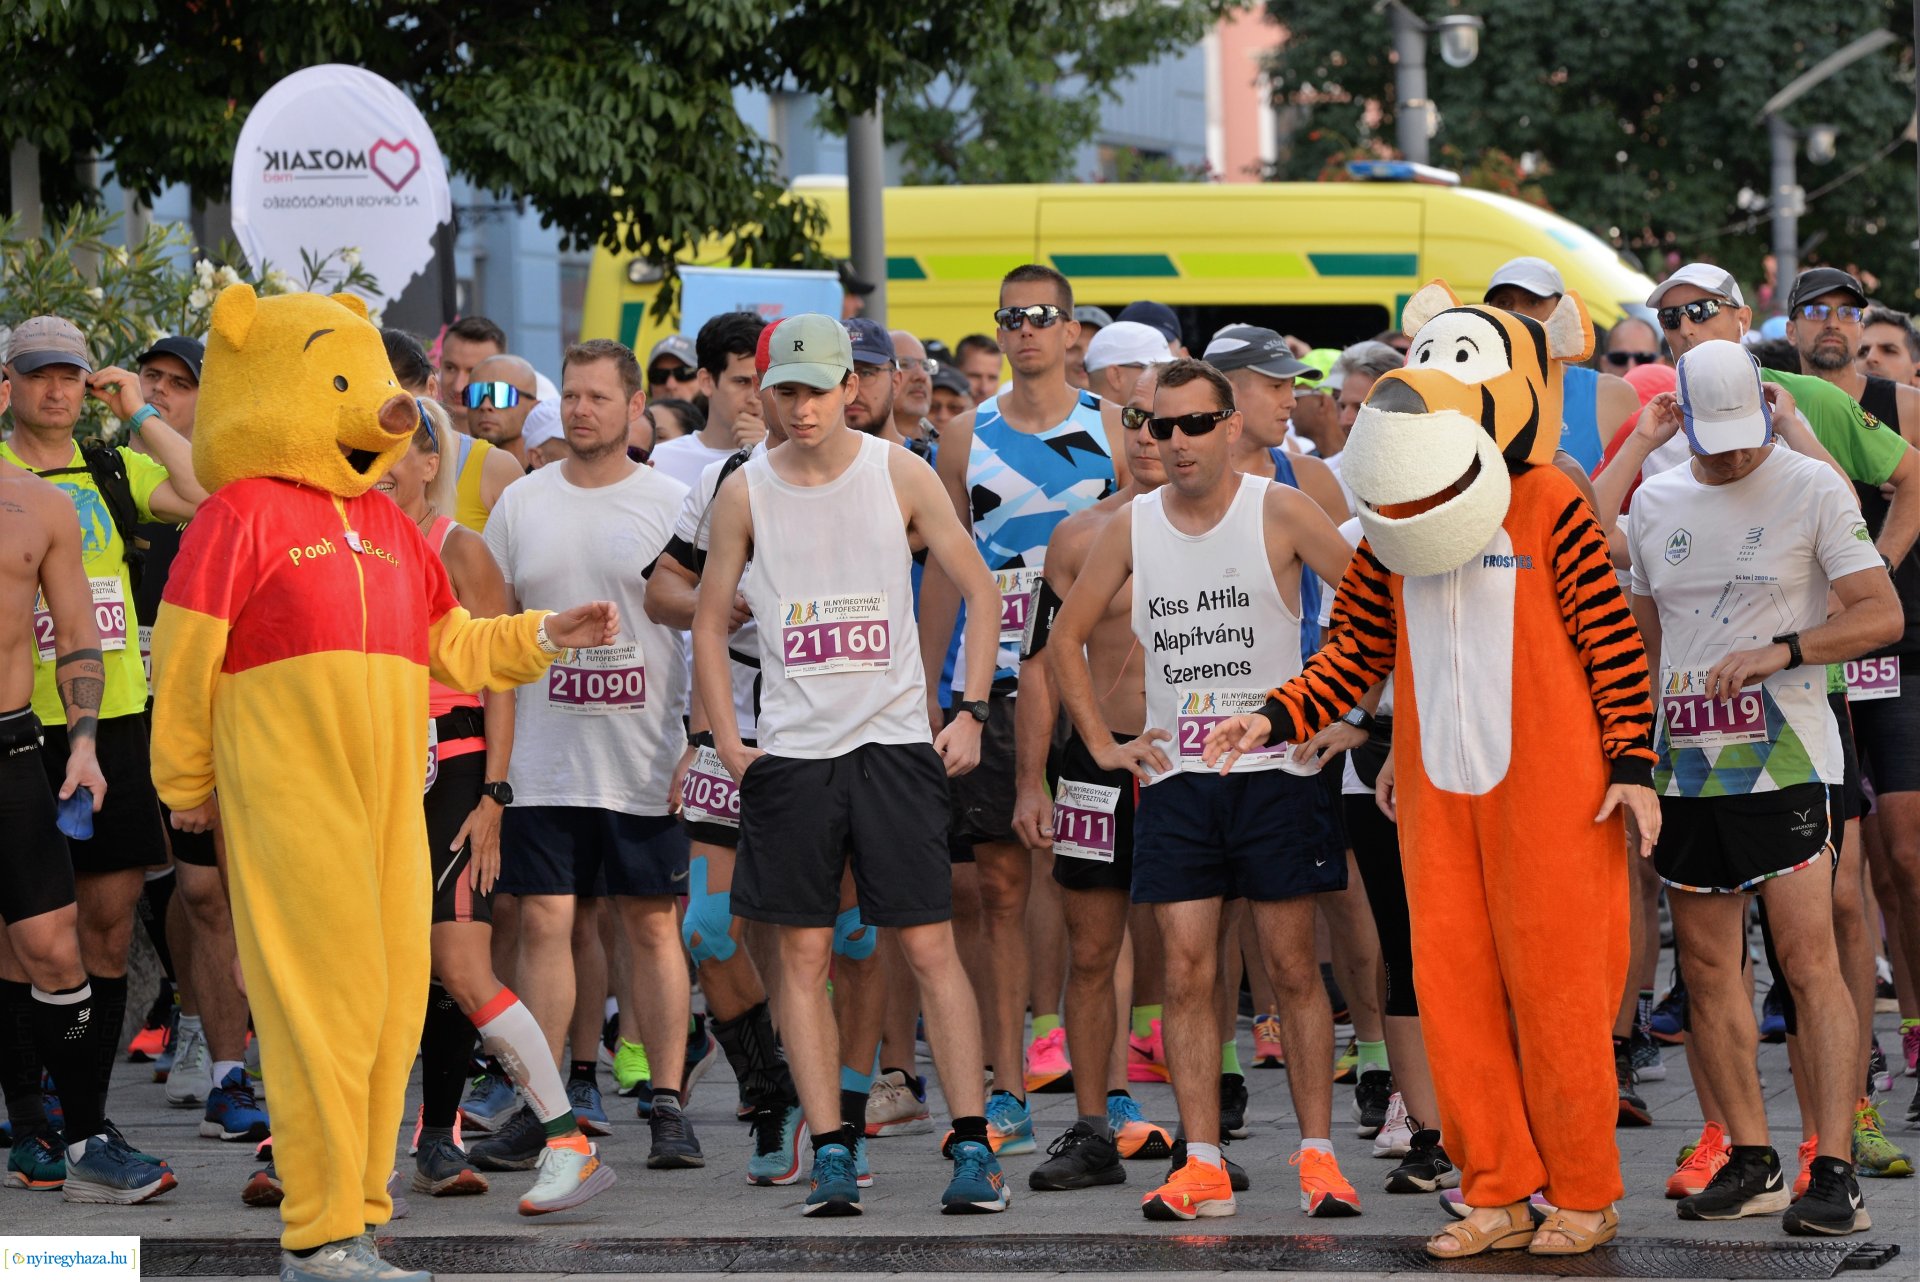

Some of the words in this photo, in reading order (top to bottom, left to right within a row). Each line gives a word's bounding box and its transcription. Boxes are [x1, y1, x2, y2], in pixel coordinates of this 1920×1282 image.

[793, 340, 804, 352] R
[288, 538, 336, 566] Pooh
[361, 539, 400, 567] Bear
[1149, 597, 1189, 620] Kiss
[1197, 586, 1250, 612] Attila
[786, 624, 886, 659] 21160
[1154, 623, 1254, 655] Alapítvány
[552, 669, 643, 699] 21090
[1164, 660, 1252, 685] Szerencs
[1843, 656, 1896, 684] 055
[1666, 695, 1760, 729] 21119
